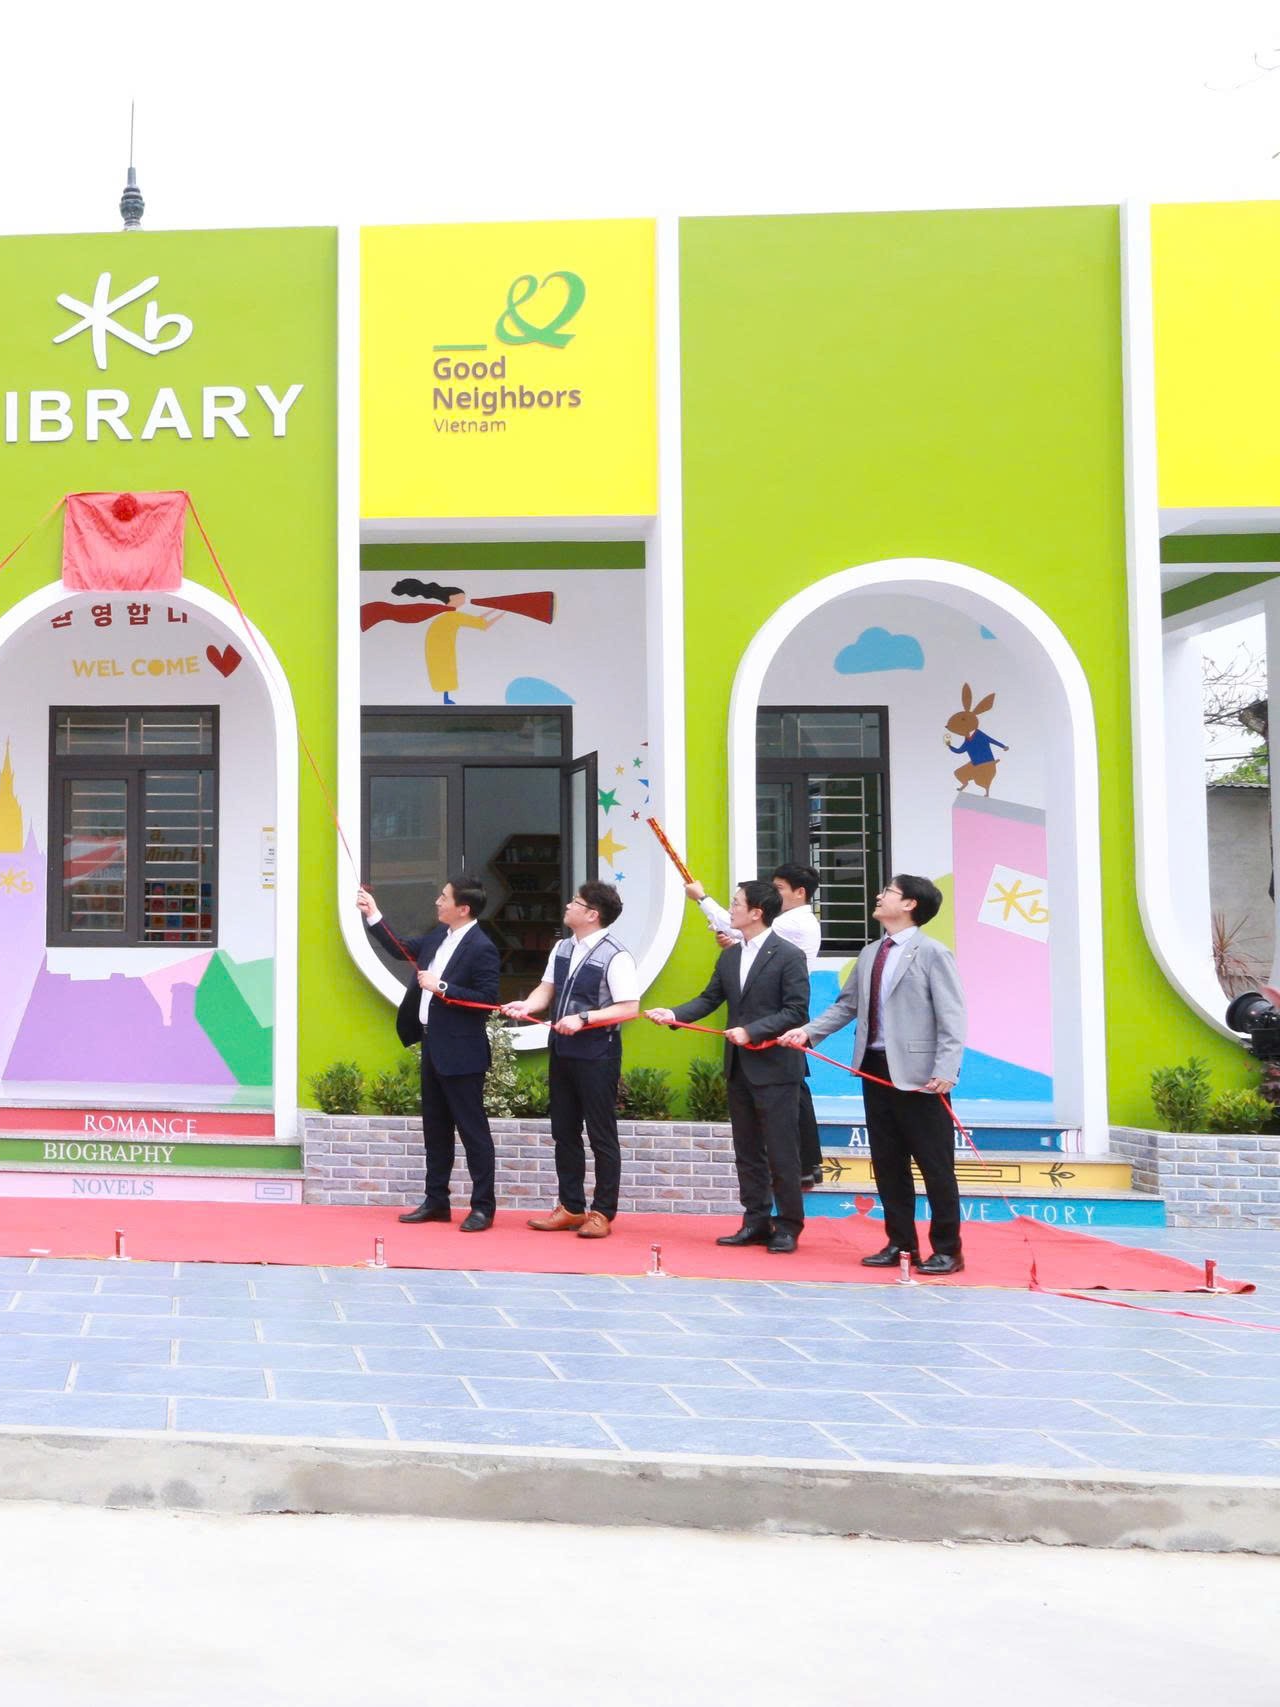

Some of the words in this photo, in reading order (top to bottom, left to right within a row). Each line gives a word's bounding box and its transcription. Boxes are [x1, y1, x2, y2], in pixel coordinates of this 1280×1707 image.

[433, 355, 506, 380] Good
[433, 385, 581, 416] Neighbors
[433, 418, 506, 433] Vietnam
[84, 1114, 197, 1136] ROMANCE
[43, 1142, 176, 1164] BIOGRAPHY
[71, 1178, 154, 1196] NOVELS
[925, 1203, 1000, 1222] LVE
